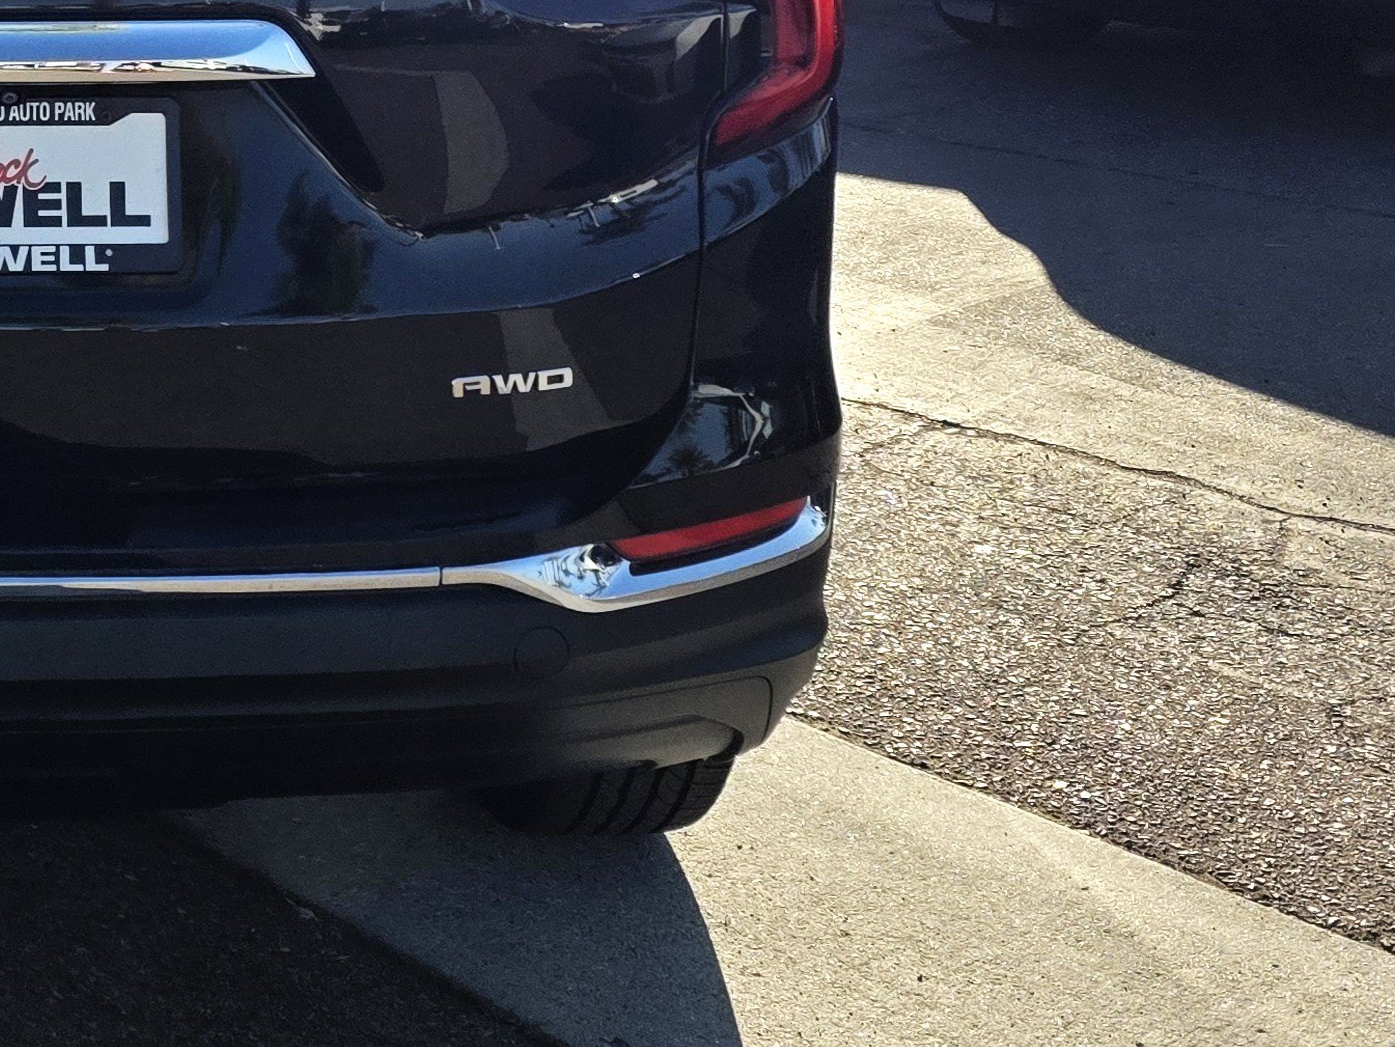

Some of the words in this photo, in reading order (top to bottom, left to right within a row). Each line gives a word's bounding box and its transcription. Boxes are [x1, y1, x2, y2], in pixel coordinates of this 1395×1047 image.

[9, 102, 51, 122] AUTO
[55, 101, 96, 121] PARK
[451, 357, 574, 398] AWD
